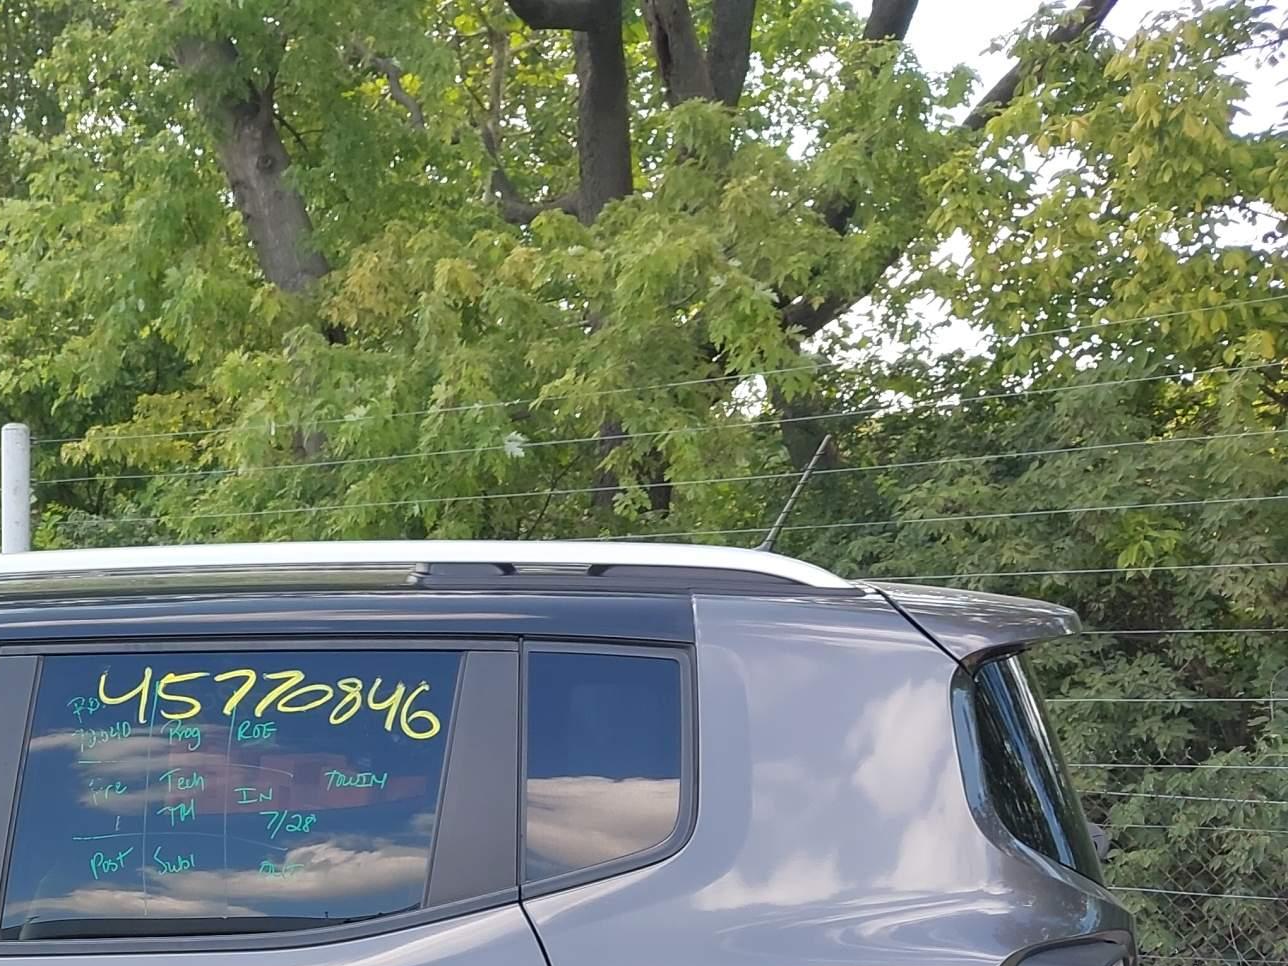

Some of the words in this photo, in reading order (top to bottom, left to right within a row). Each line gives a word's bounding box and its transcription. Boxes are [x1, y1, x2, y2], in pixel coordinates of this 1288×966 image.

[98, 666, 442, 740] 45770846
[159, 767, 205, 793] Tech
[233, 787, 273, 804] IN
[259, 809, 317, 840] 7/28
